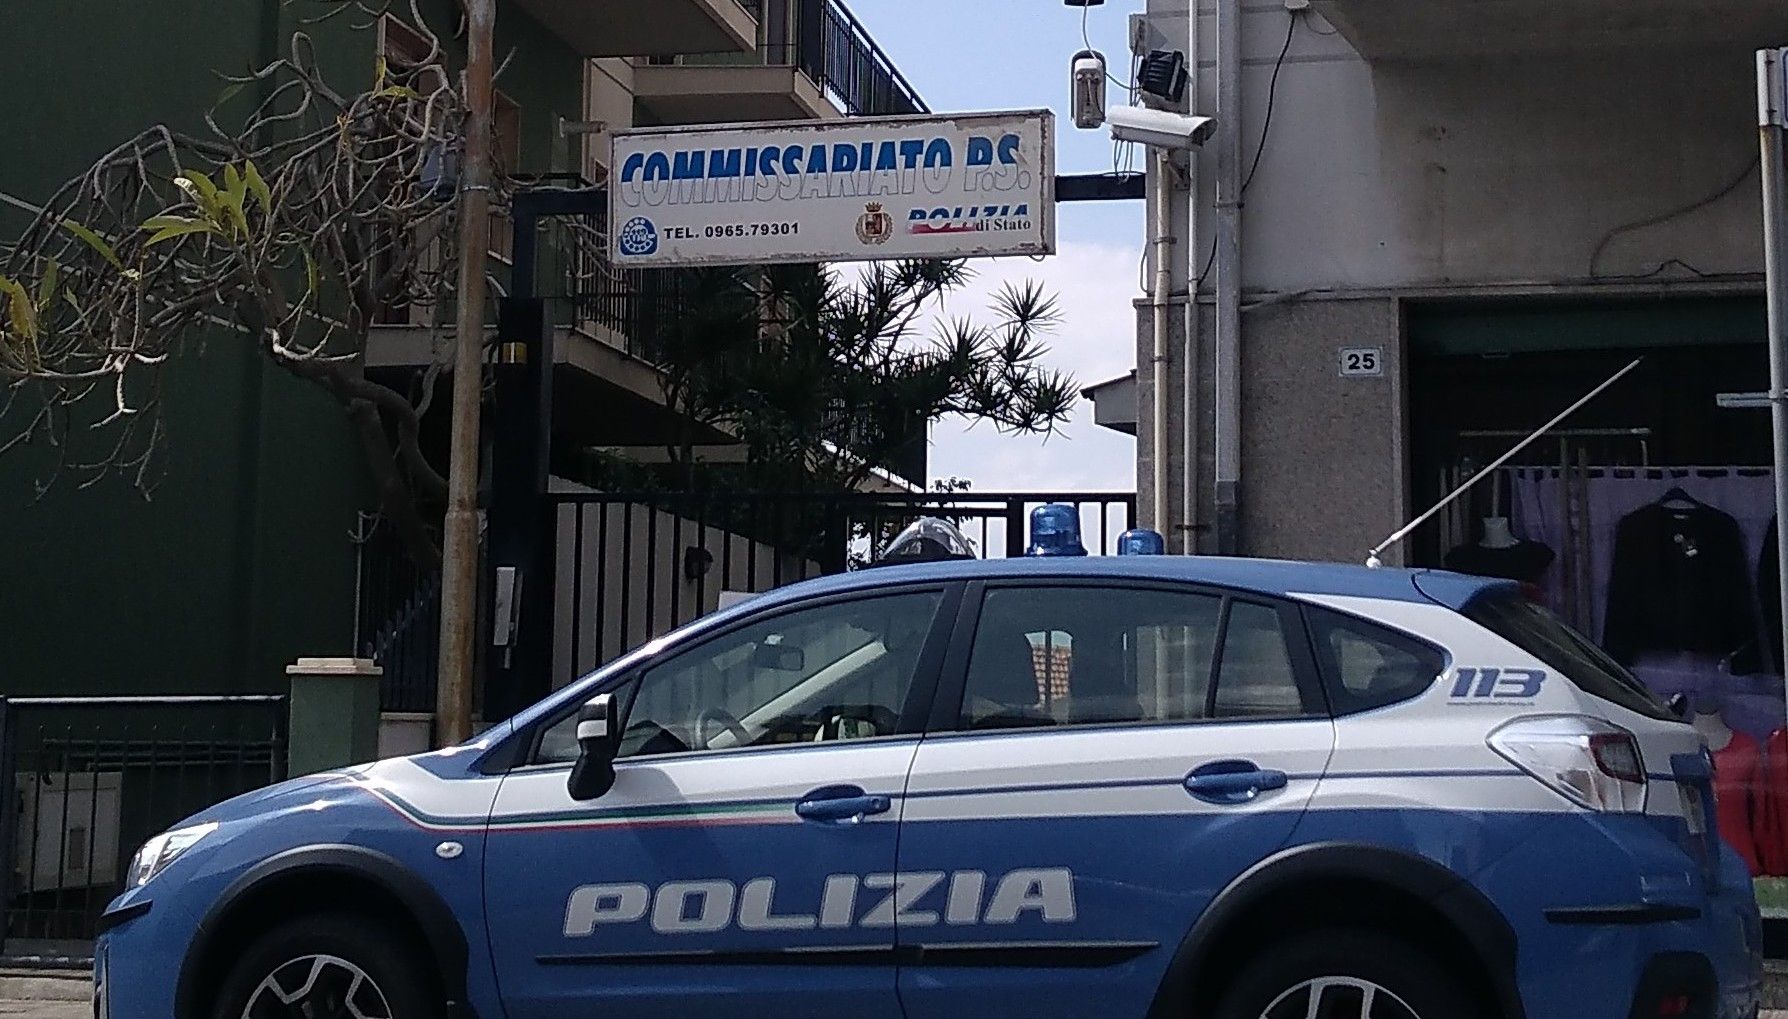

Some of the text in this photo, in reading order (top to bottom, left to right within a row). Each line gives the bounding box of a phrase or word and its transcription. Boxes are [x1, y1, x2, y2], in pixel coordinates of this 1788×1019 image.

[621, 134, 1031, 207] COMMISSARIATO P.S.
[664, 222, 800, 239] TEL. 0965.79301
[907, 204, 1029, 231] POLIZIA
[976, 217, 1031, 232] di Stato
[1347, 353, 1375, 370] 25
[1450, 668, 1547, 697] 113
[563, 866, 1077, 937] POLIZIA
